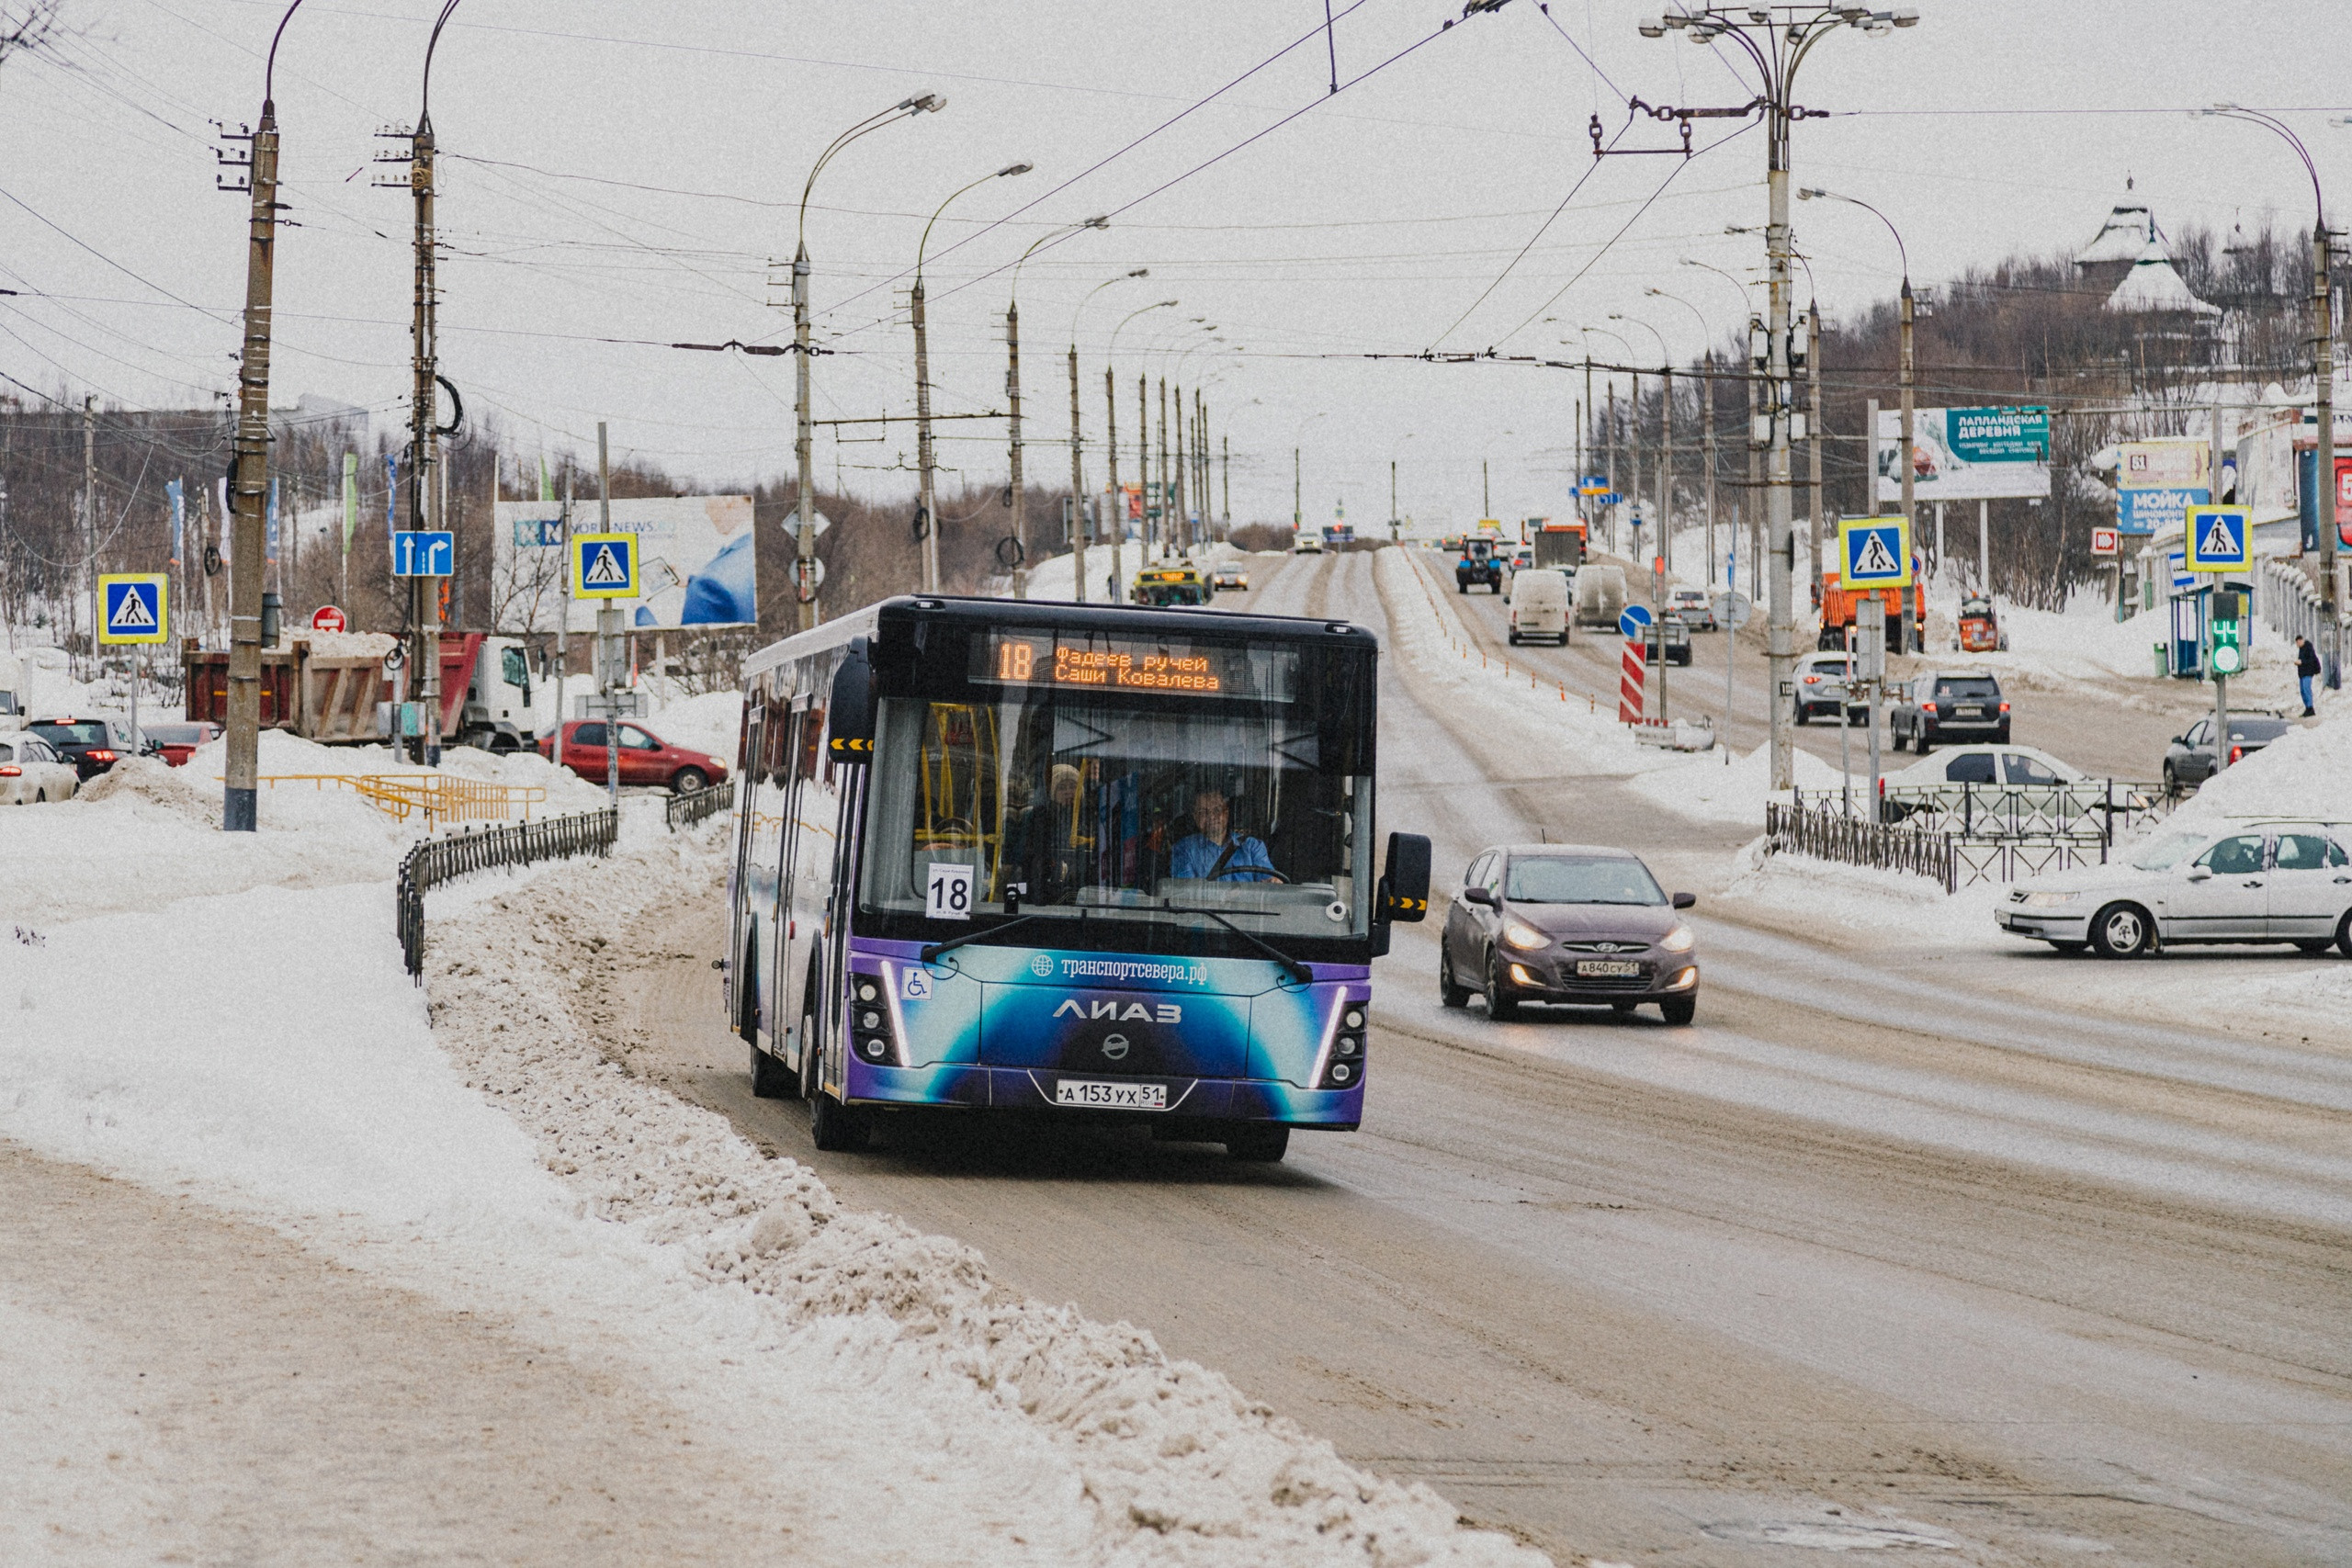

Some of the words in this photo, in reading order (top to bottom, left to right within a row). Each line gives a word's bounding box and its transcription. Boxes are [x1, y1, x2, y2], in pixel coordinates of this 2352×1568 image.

[1959, 414, 2042, 427] ЛАПЛАНДСКАЯ
[1959, 425, 2021, 439] ДЕРЕВНЯ
[2132, 488, 2194, 509] МОЙКА
[2213, 620, 2239, 643] 44
[1000, 643, 1031, 680] 18
[1057, 646, 1132, 668] Фадеев
[1144, 656, 1207, 671] ручей
[1056, 663, 1106, 683] Саши
[1117, 668, 1219, 692] Ковалева
[932, 877, 967, 910] 18
[1061, 959, 1207, 985] транспортсевера.рф
[1053, 999, 1182, 1024] ЛИАЗ
[1142, 1087, 1159, 1100] 51
